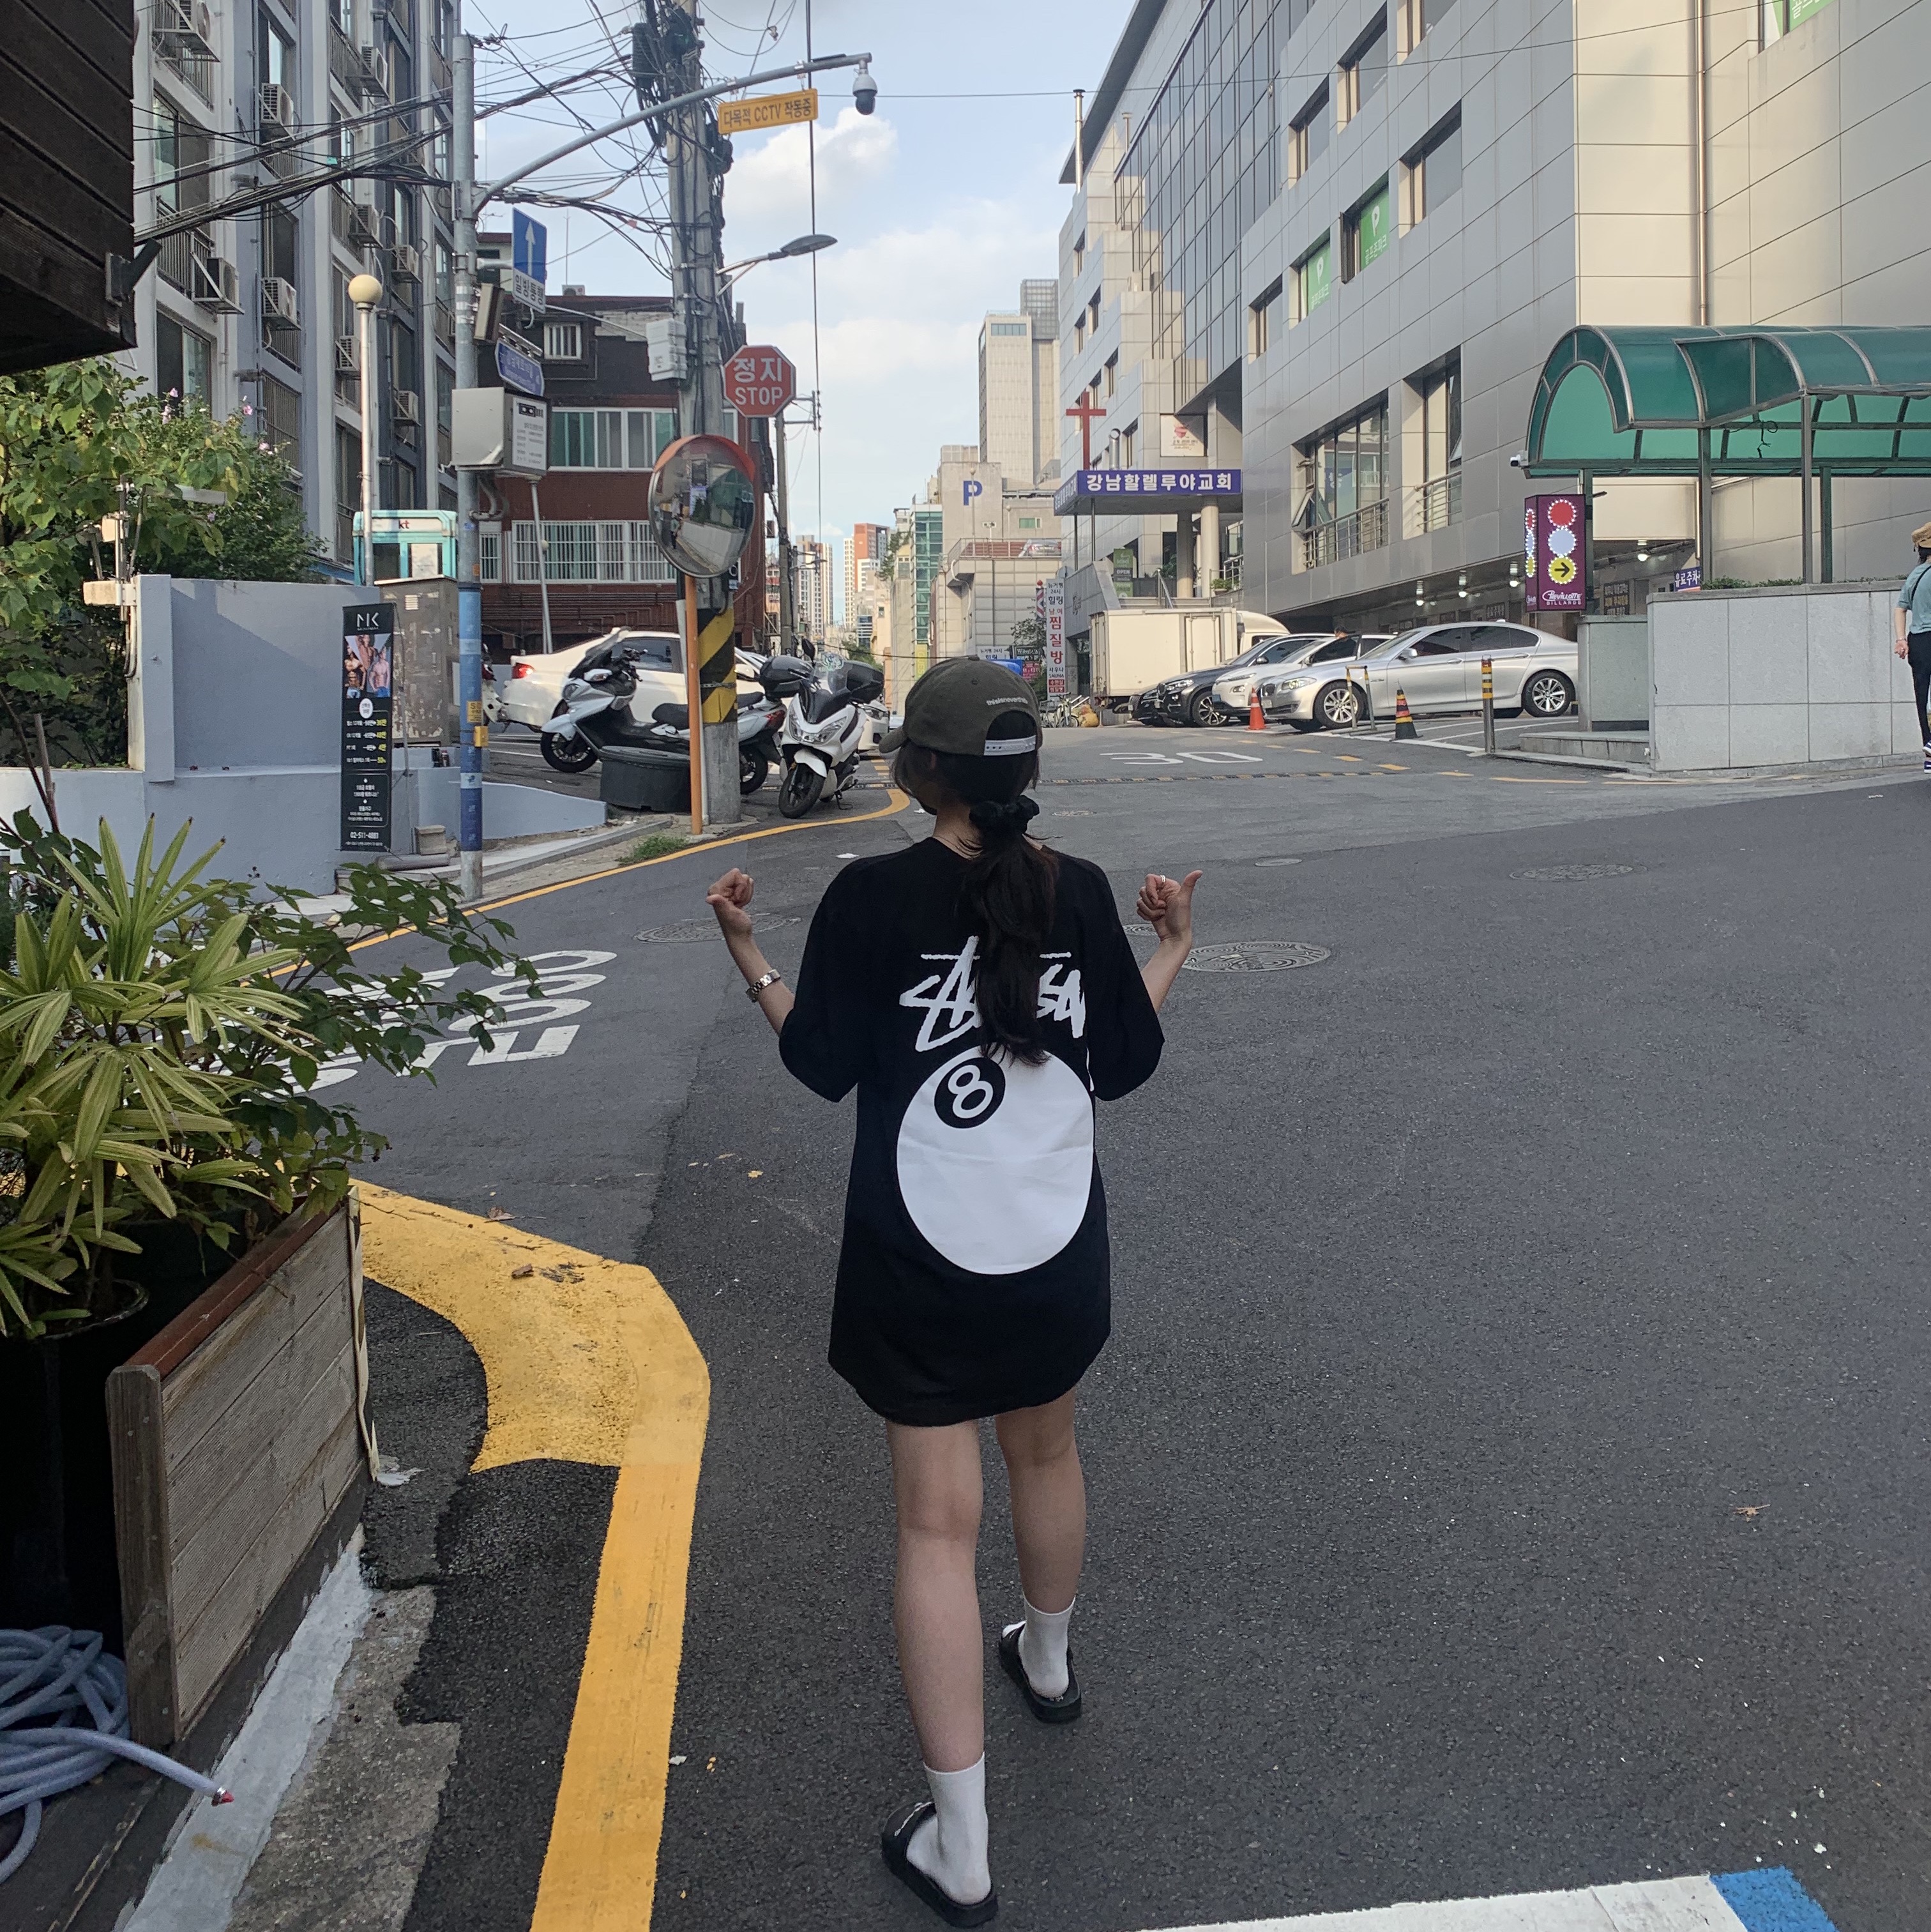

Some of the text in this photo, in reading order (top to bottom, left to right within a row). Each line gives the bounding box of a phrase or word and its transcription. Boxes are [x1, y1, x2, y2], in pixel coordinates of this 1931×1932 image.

[723, 98, 812, 127] 다목적 CCTV 작동중
[515, 275, 543, 305] 일방통행
[733, 358, 782, 383] 정지
[735, 386, 783, 406] STOP
[963, 480, 983, 506] P
[1087, 473, 1231, 492] 강남할렐루야교회
[398, 521, 409, 529] kt
[1049, 596, 1063, 605] 힐링
[1049, 616, 1063, 665] 찜질방
[1099, 751, 1264, 764] 30
[948, 1065, 994, 1118] 8
